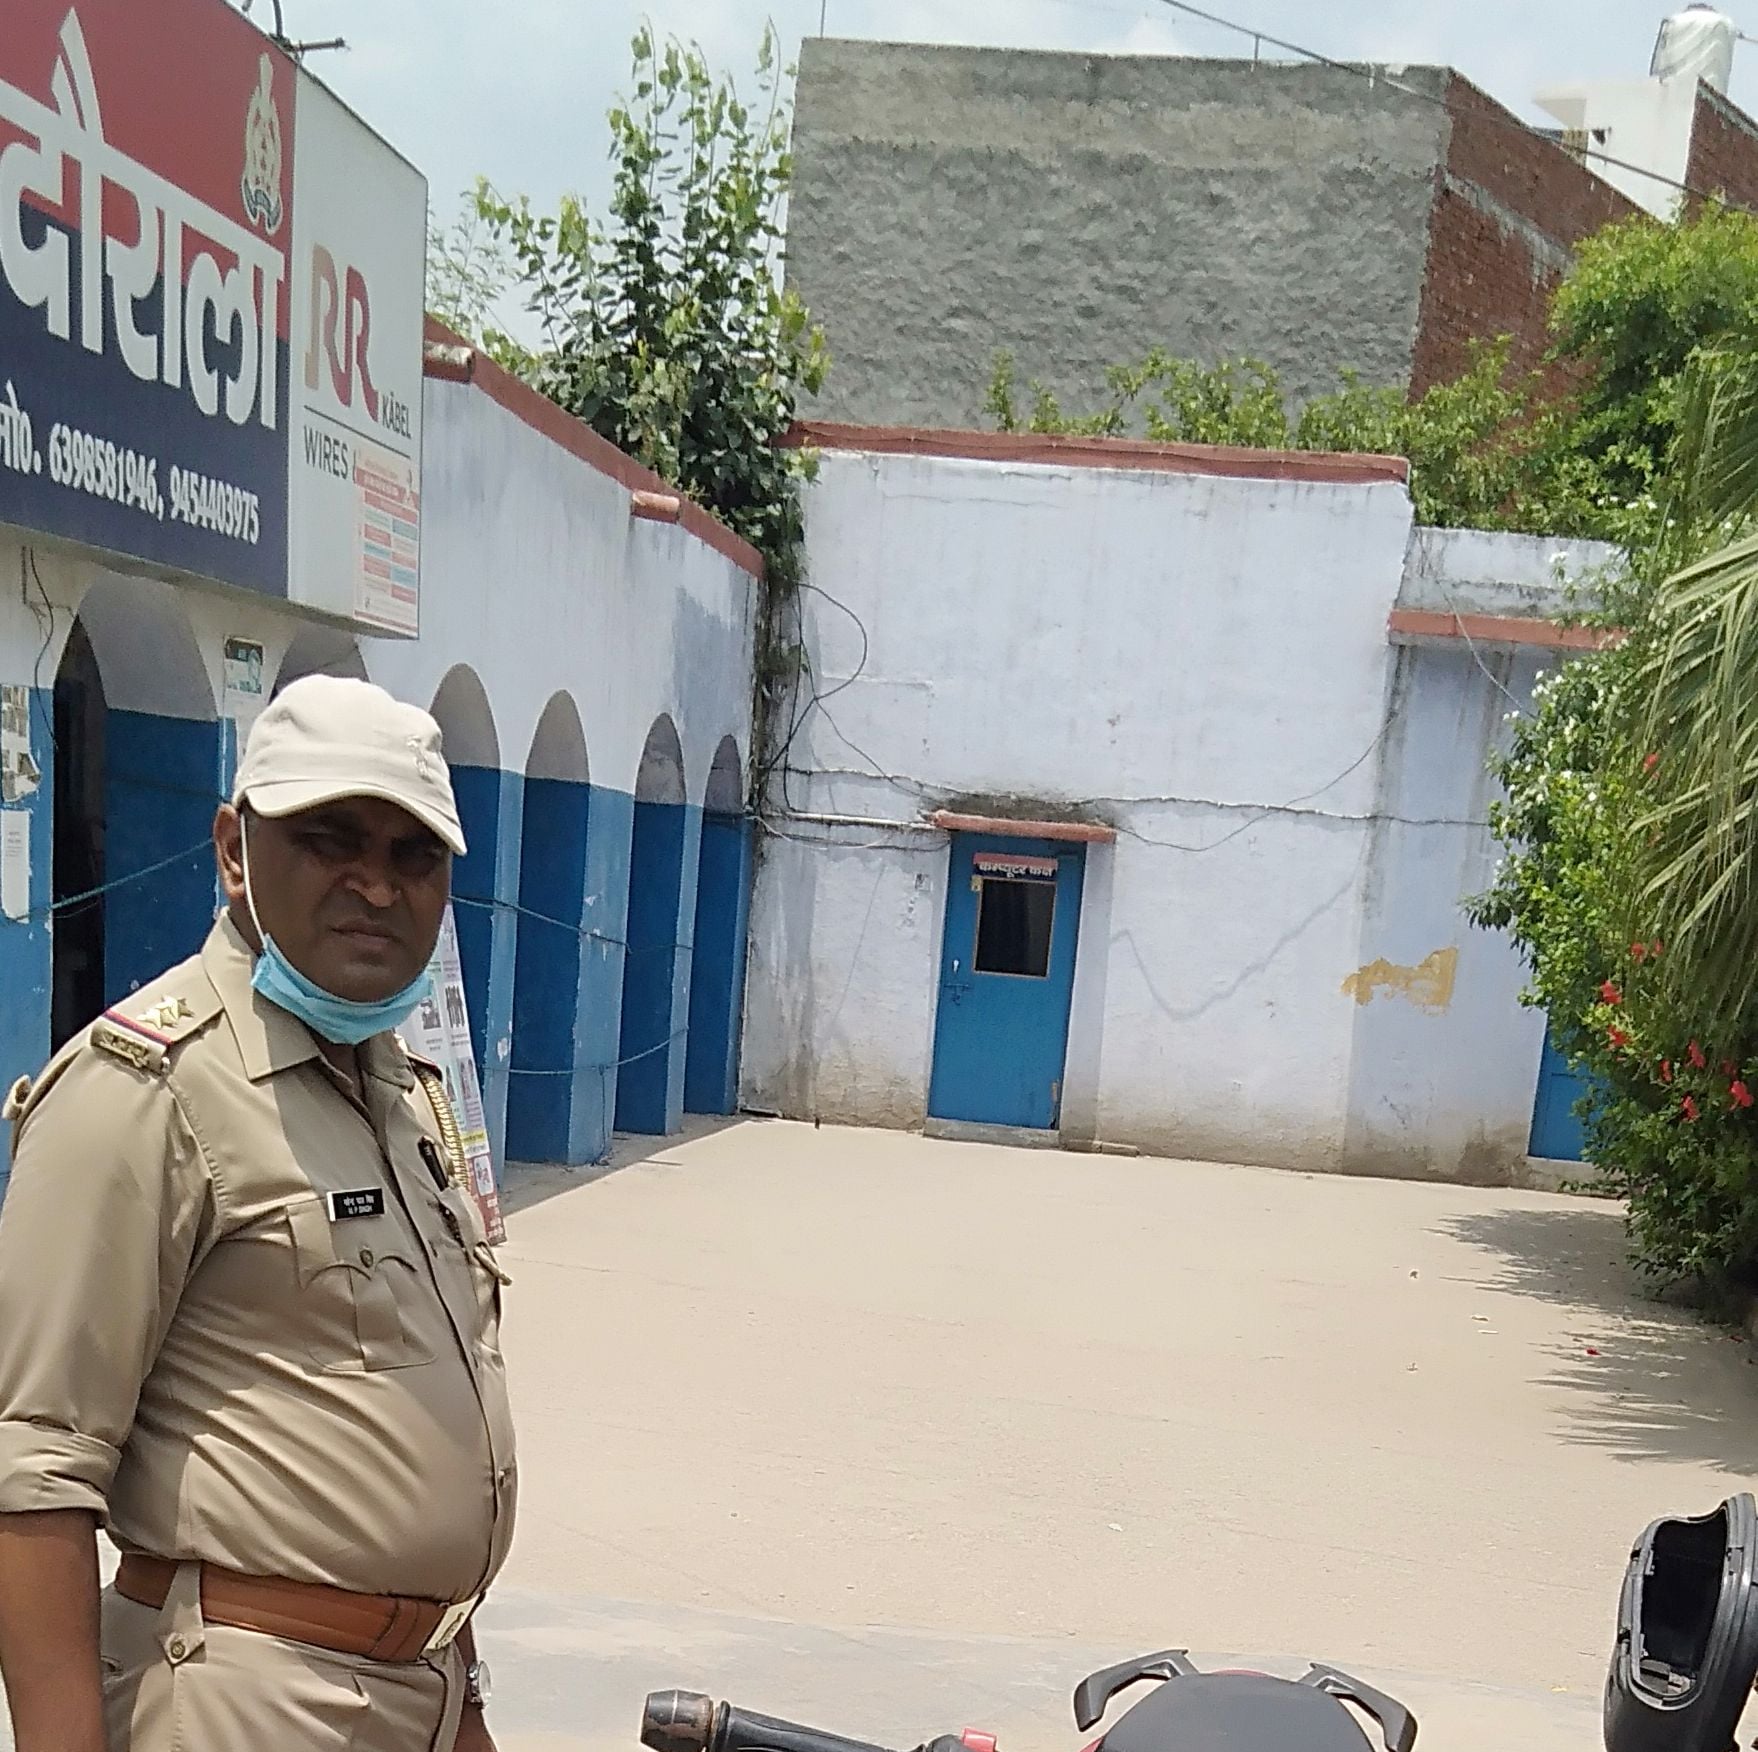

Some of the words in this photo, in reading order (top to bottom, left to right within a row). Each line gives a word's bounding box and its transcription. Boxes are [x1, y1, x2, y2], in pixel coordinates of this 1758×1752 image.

[0, 7, 286, 430] दौराला
[304, 242, 379, 423] RR
[49, 422, 164, 522] 6398581946,
[170, 465, 259, 545] 9454403975
[304, 424, 348, 480] WIRES
